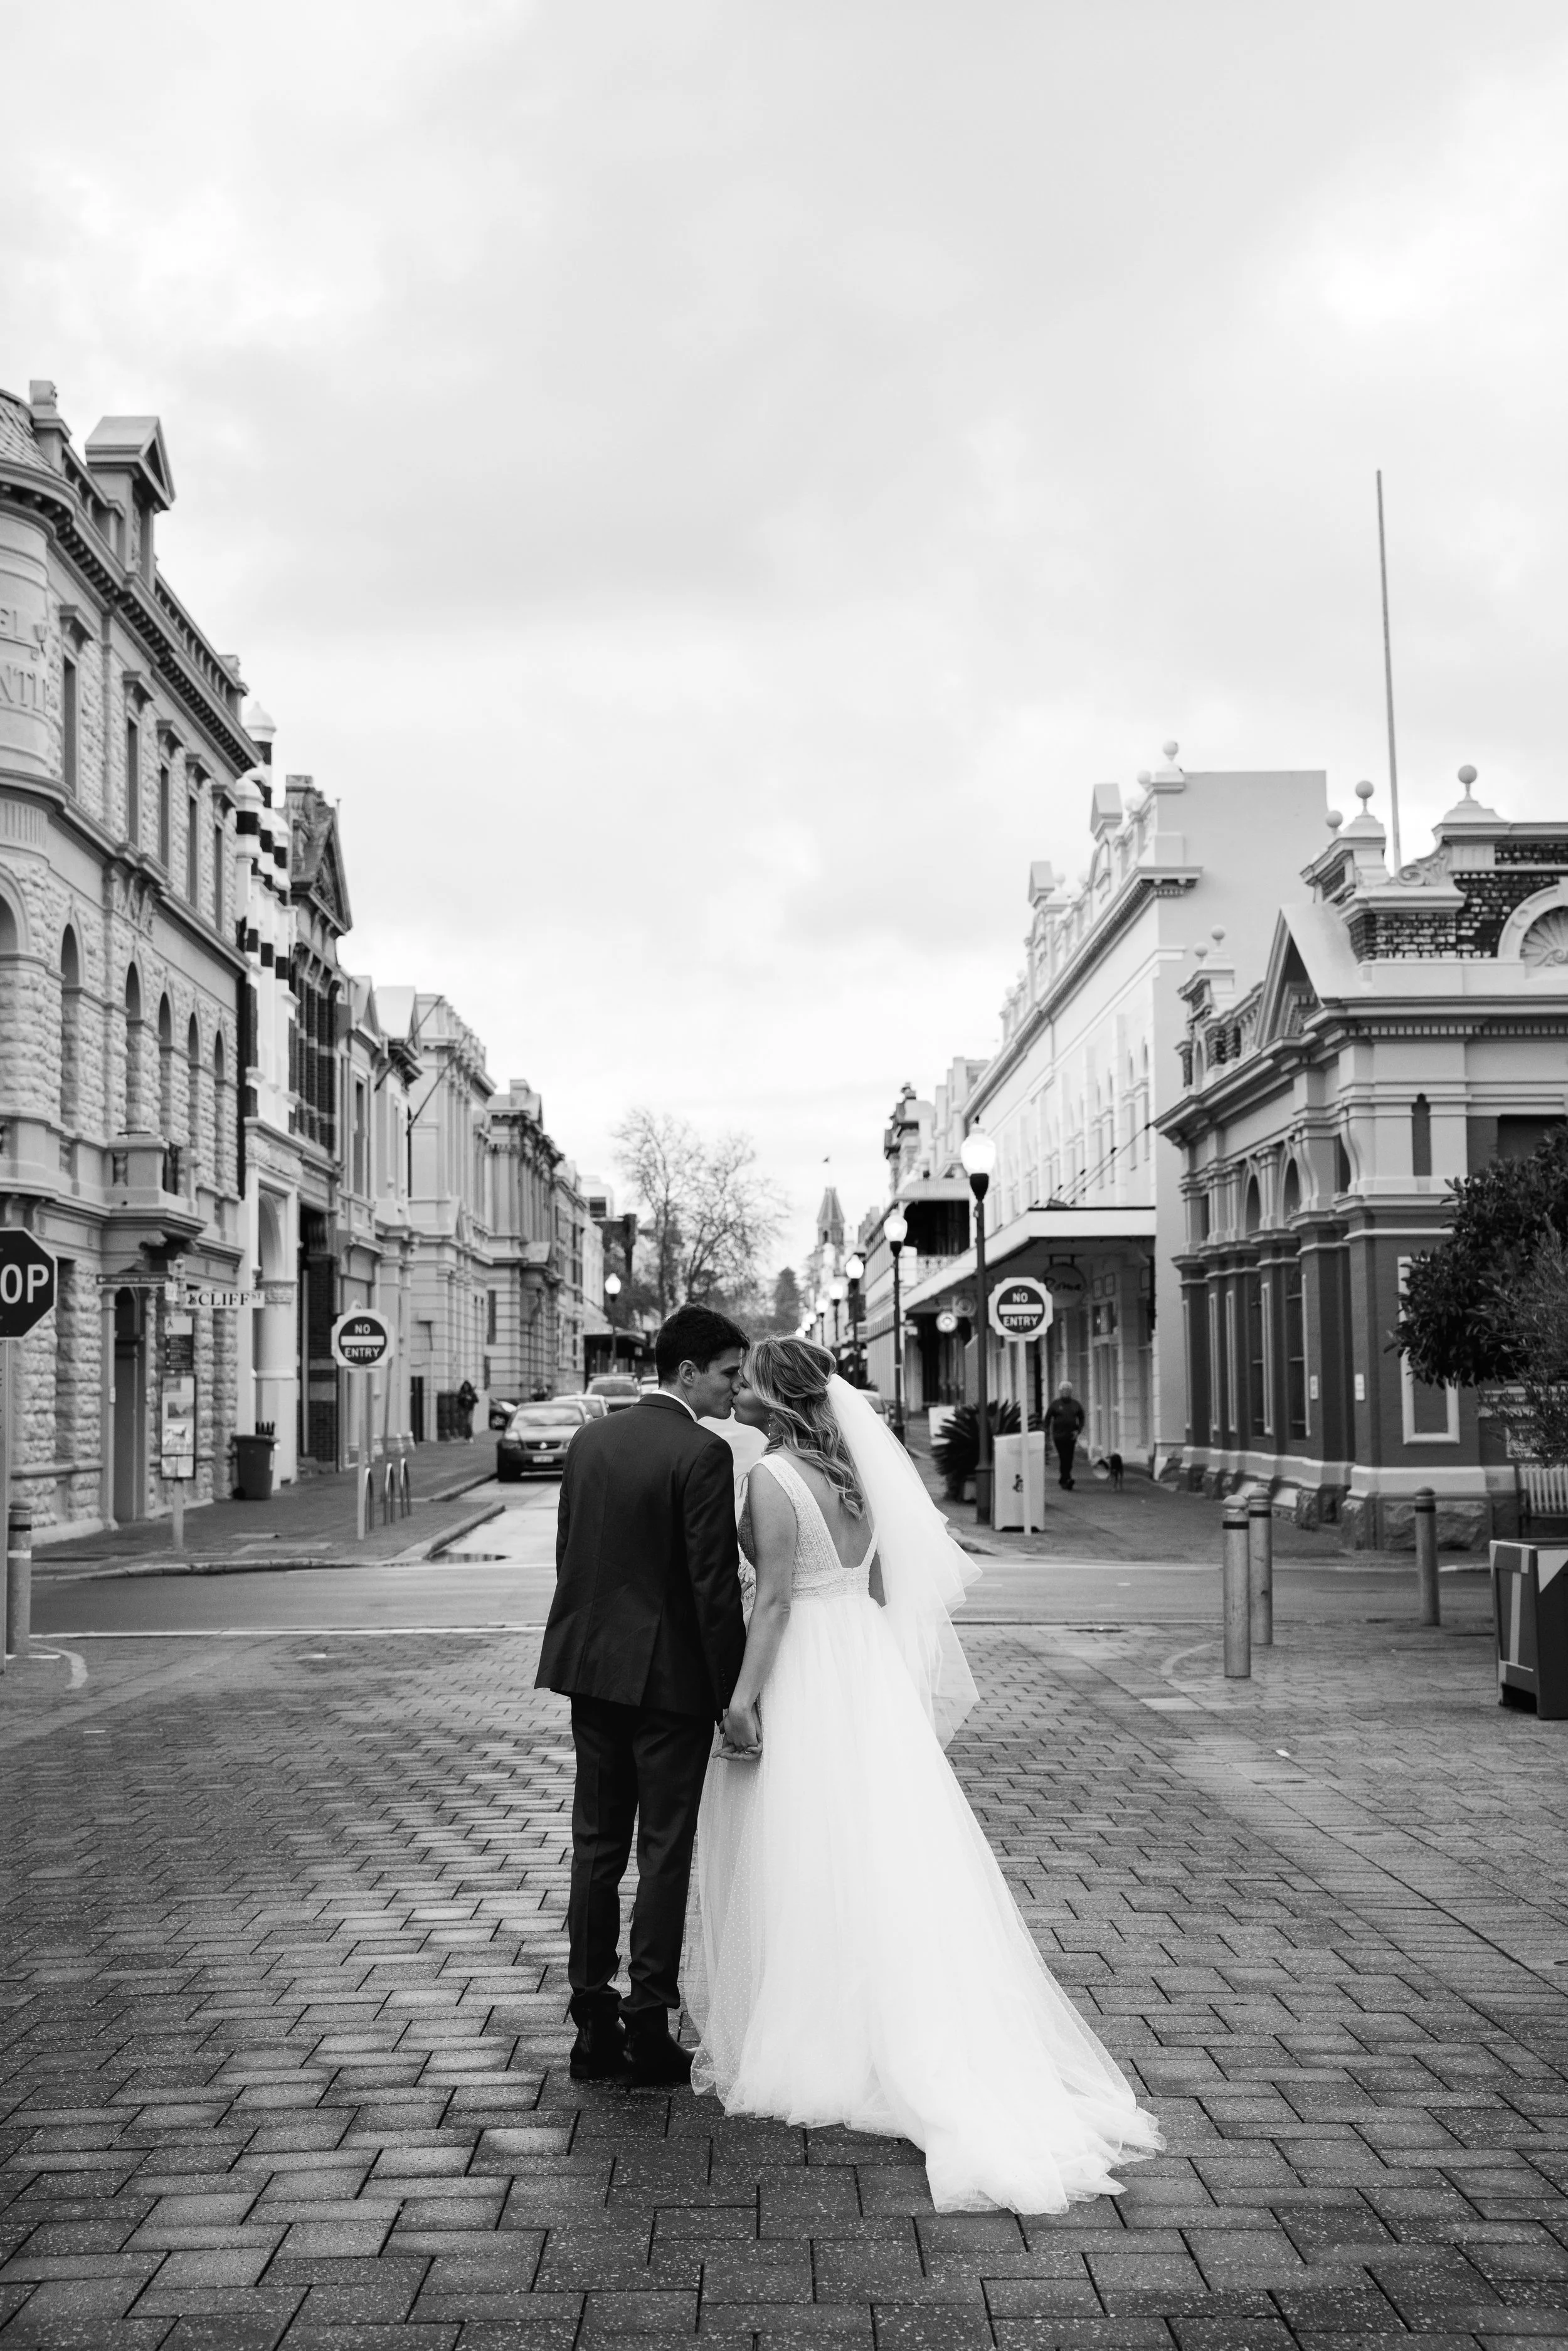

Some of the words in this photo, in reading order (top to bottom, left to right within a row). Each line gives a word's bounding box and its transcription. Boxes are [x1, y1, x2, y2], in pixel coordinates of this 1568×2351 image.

[0, 1263, 49, 1304] OP
[199, 1293, 250, 1305] CLIFF
[1012, 1292, 1028, 1303] NO
[1004, 1316, 1039, 1327] ENTRY
[354, 1324, 371, 1334] NO
[344, 1347, 379, 1357] ENTRY
